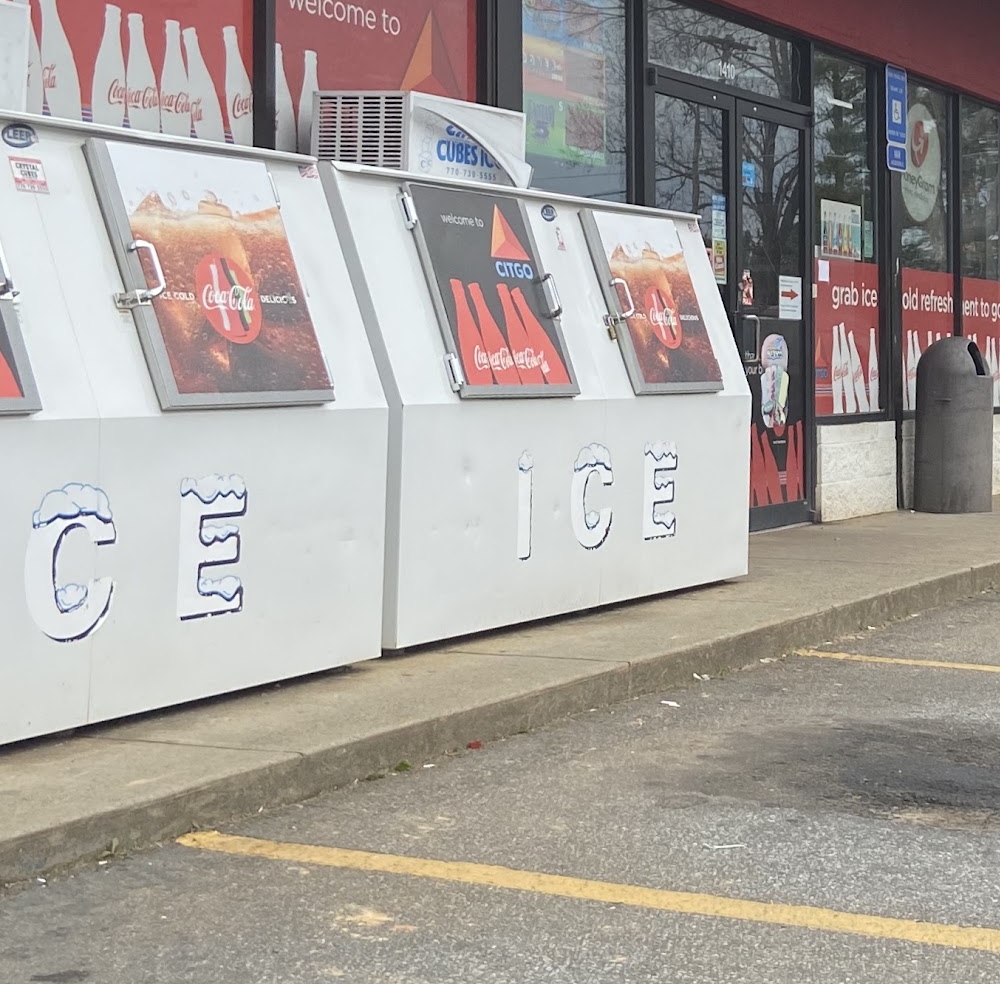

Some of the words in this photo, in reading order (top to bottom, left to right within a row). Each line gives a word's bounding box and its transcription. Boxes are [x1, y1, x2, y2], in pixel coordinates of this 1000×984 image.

[382, 8, 401, 36] to
[718, 60, 736, 80] 1410
[436, 139, 479, 167] CUBES
[480, 148, 502, 171] IC
[440, 212, 475, 227] welcome
[475, 217, 485, 229] to
[495, 260, 534, 280] CITGO
[174, 292, 196, 302] COLD
[832, 282, 859, 310] grab
[861, 283, 878, 308] ice
[901, 286, 919, 310] old
[980, 298, 990, 317] to
